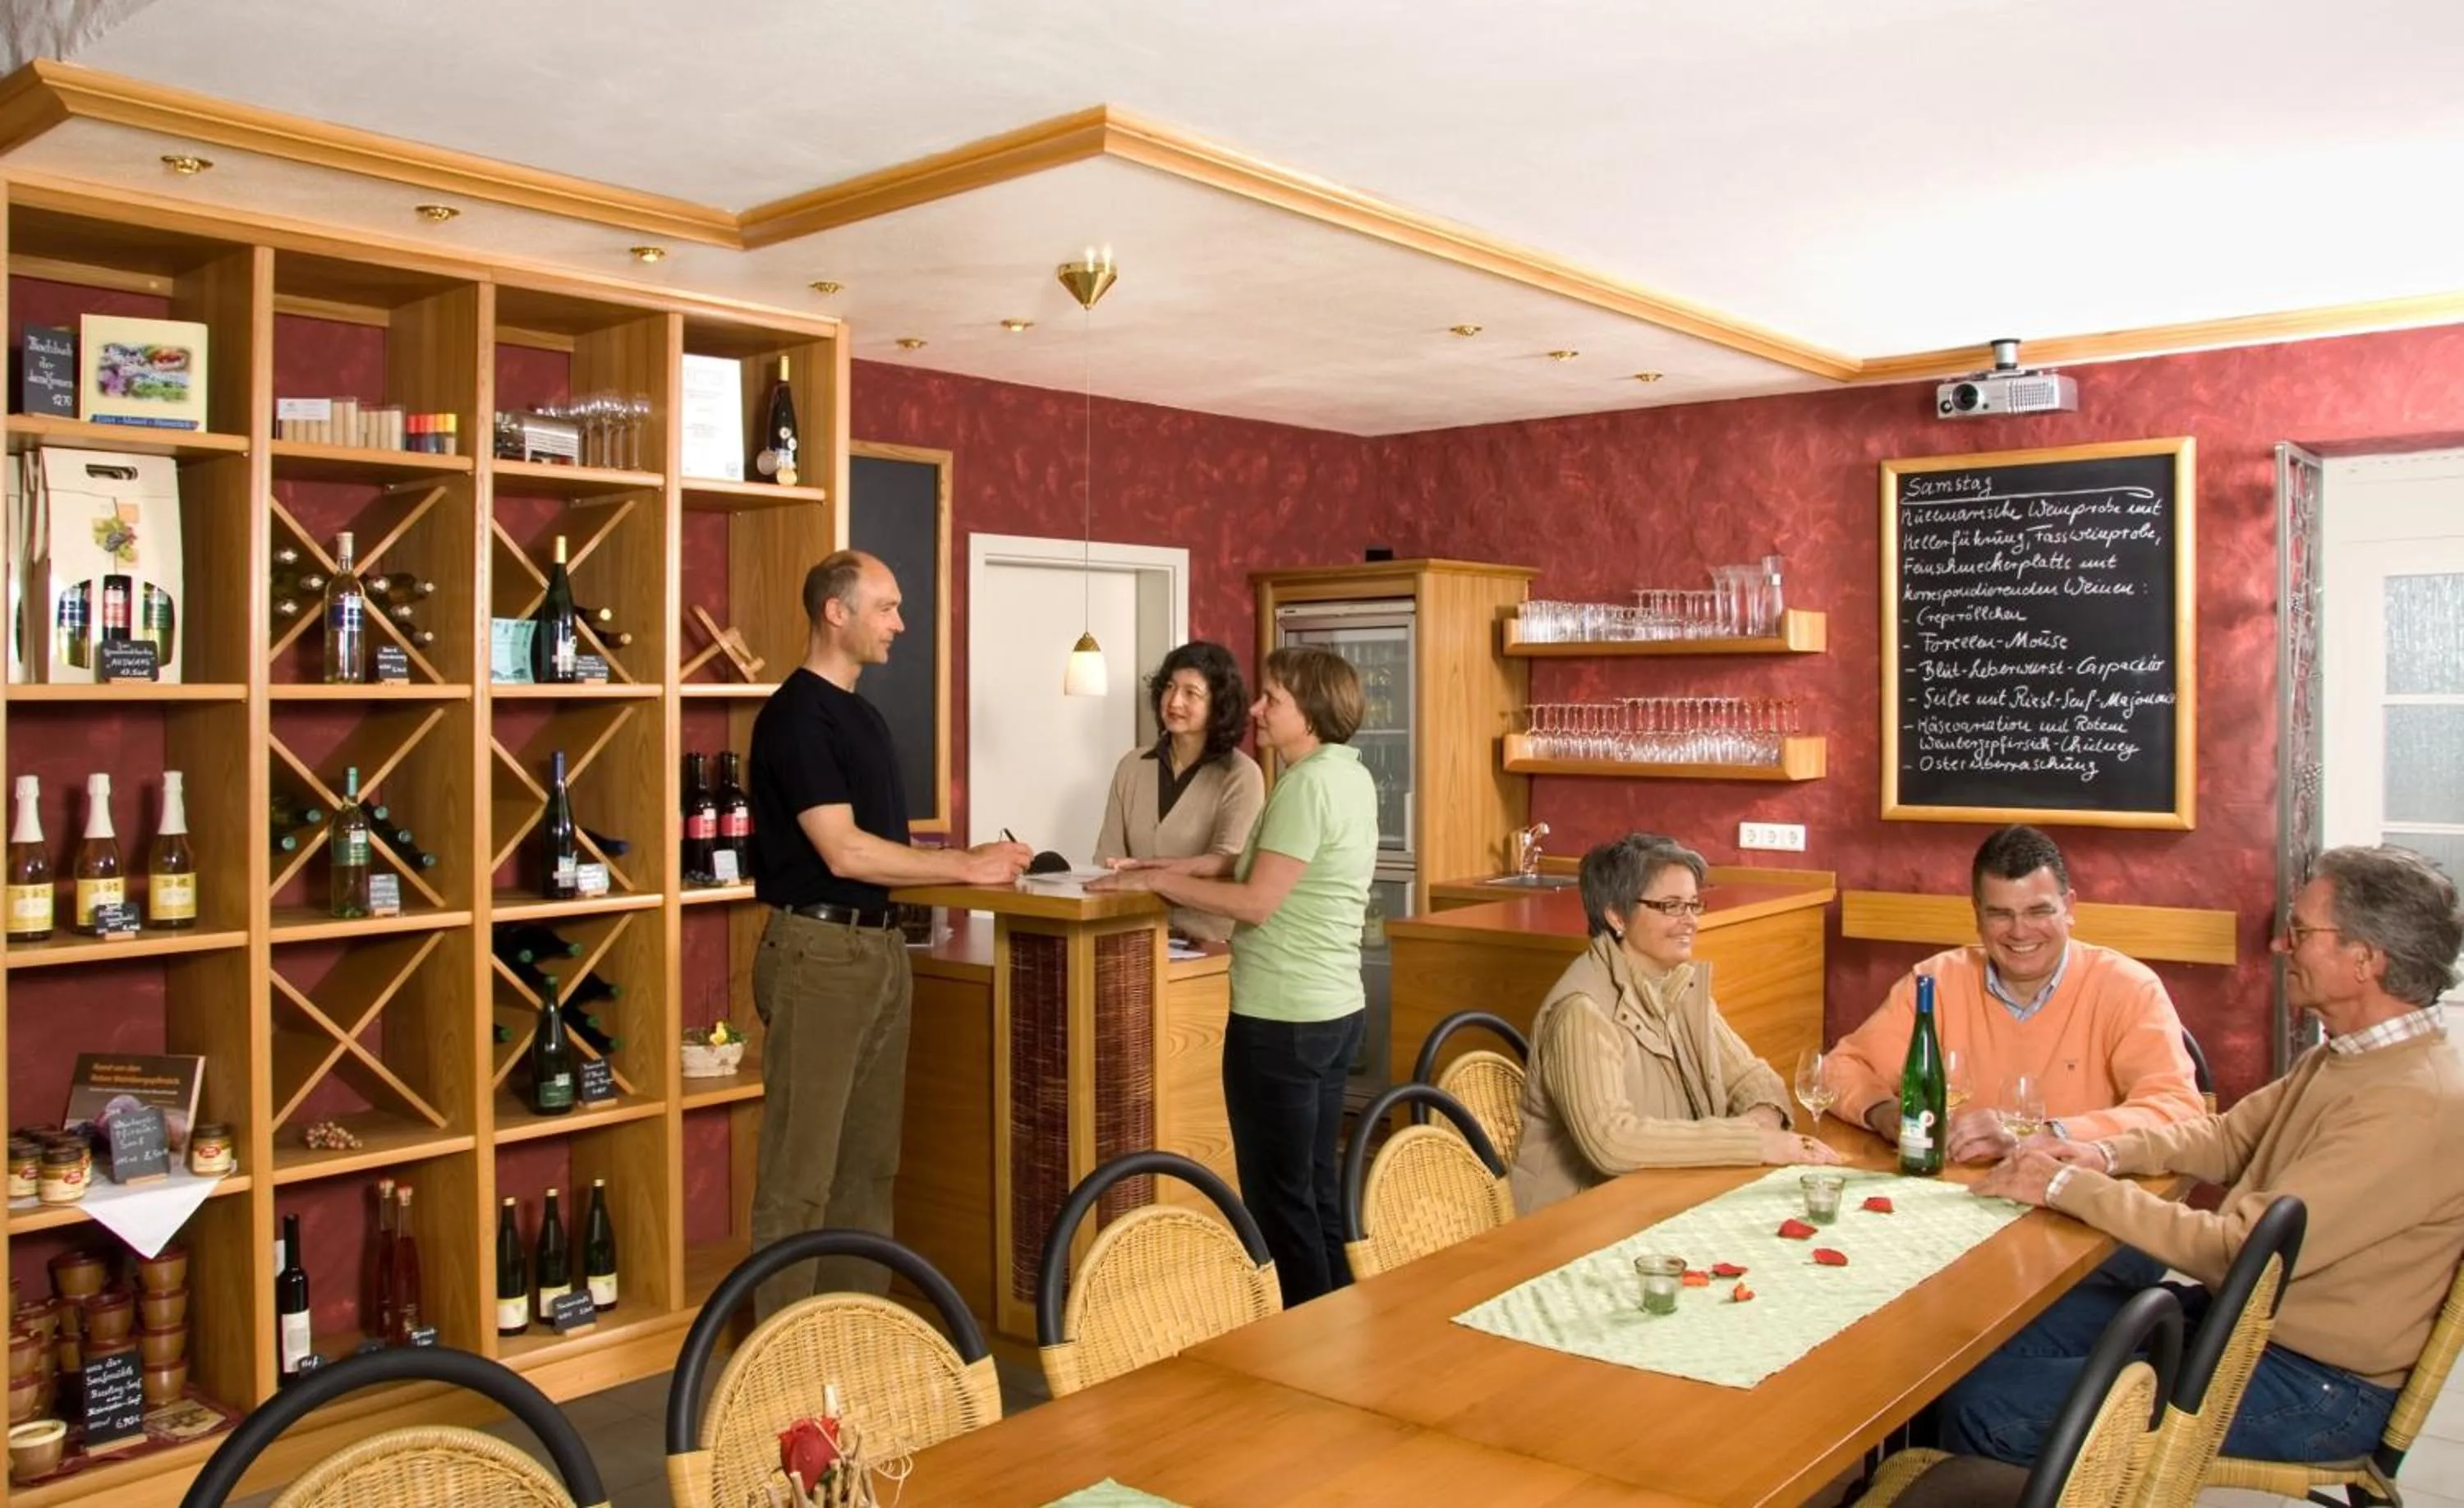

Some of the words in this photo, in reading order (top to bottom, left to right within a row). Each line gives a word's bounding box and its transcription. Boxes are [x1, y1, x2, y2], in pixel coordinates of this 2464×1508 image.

[1905, 474, 1993, 499] Samstag
[2027, 496, 2122, 526] Weinprobe
[2125, 499, 2163, 516] mit
[2078, 554, 2118, 570] mit
